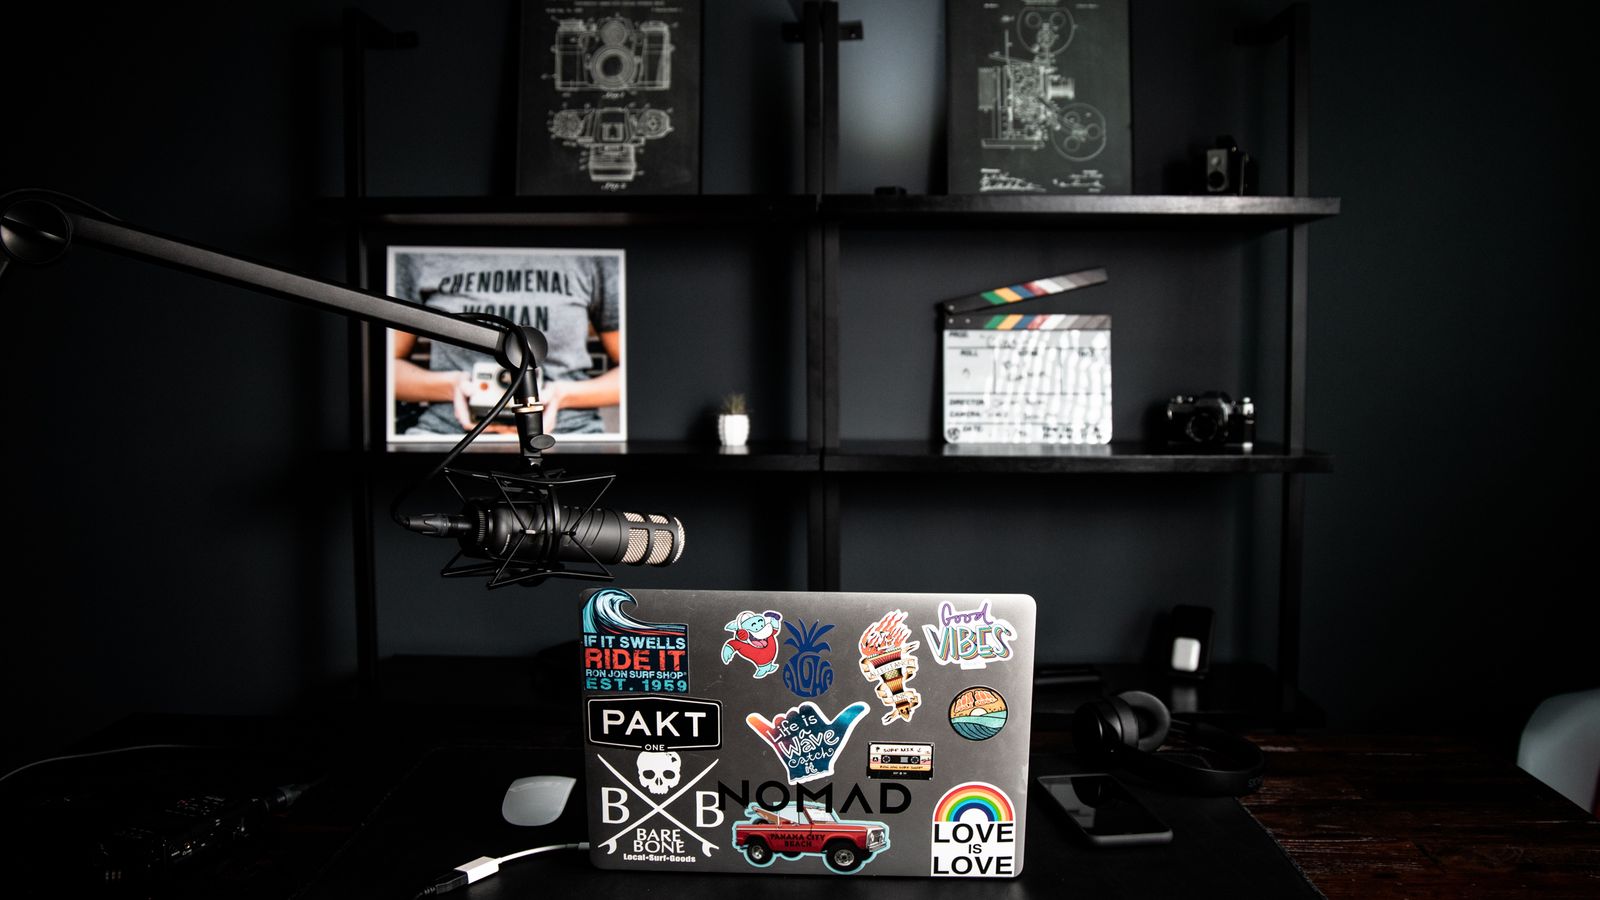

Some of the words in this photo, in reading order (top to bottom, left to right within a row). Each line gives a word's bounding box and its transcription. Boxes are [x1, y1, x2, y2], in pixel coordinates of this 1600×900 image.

[438, 269, 573, 297] PHENOMENAL
[941, 603, 994, 627] Good
[583, 634, 598, 647] IF
[600, 635, 616, 648] IT
[619, 636, 686, 650] SWELLS
[922, 624, 1012, 661] VIBES
[585, 648, 651, 671] RIDE
[659, 650, 686, 671] IT
[585, 669, 607, 678] RON
[607, 670, 628, 678] JON
[629, 671, 655, 679] SURF
[586, 678, 634, 691] EST.
[642, 679, 688, 692] 1959
[602, 709, 707, 738] PAKT
[766, 720, 800, 743] Life
[801, 715, 818, 727] is
[798, 729, 812, 740] a
[778, 730, 840, 760] Wave
[804, 762, 818, 774] it
[601, 787, 630, 824] B
[717, 779, 912, 814] NOMAD
[695, 790, 725, 828] B
[636, 828, 682, 842] BARE
[806, 833, 826, 841] CITY
[934, 823, 1014, 843] LOVE
[633, 840, 686, 853] BONE
[784, 840, 812, 848] BEACH
[968, 844, 982, 854] IS
[933, 856, 1013, 875] LOVE
